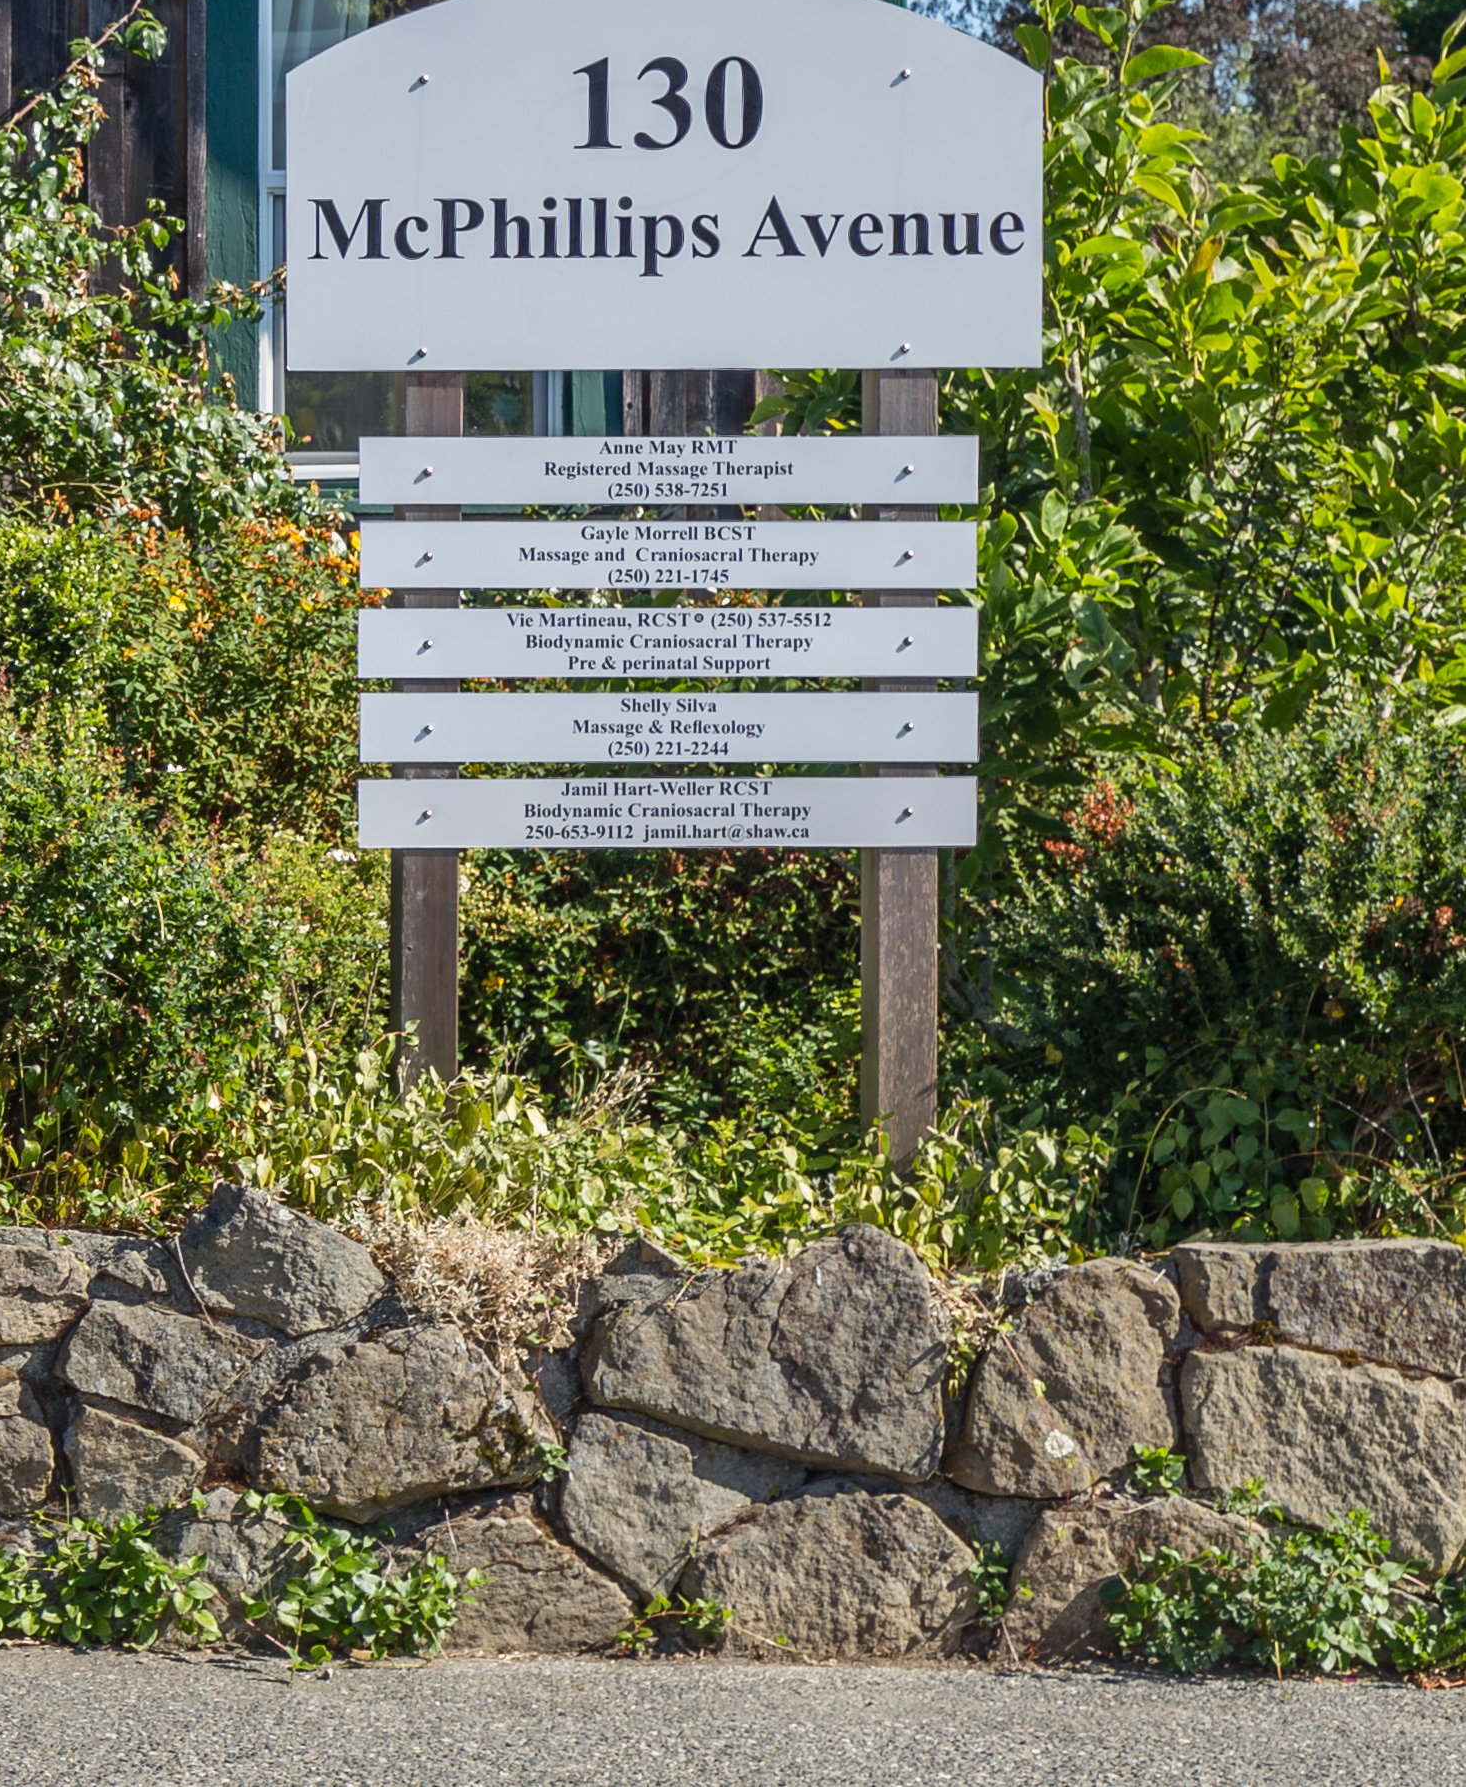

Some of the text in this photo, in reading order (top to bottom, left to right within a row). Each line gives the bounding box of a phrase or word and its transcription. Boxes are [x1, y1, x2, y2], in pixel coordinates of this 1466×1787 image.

[572, 55, 764, 151] 130
[307, 195, 1025, 278] McPhillips Avenue
[599, 439, 738, 459] Anne May RMT
[544, 460, 793, 480] Registered Massage Therapist
[607, 482, 728, 501] (250) 538-7251
[580, 525, 757, 545] Gayle Morrell BCST
[519, 547, 820, 567] Massage and Craniosacral Therapy
[607, 568, 729, 586] (250) 221-1745
[539, 612, 632, 630] Martineau,
[710, 612, 753, 630] (250)
[757, 612, 832, 628] 537-5512
[526, 633, 814, 653] Biodynamic Craniosacral Therapy
[568, 655, 770, 675] Pre & perinatal Support
[620, 697, 717, 717] Shelly Silva
[572, 719, 766, 739] Massage & Reflexology
[607, 740, 729, 759] (250) 221-2244
[560, 780, 773, 797] Jamil Hart-Weller RCST
[524, 802, 812, 822] Biodynamic Craniosacral Therapy
[525, 823, 810, 844] 250-653-9112 jamil.hart@shaw.ca
